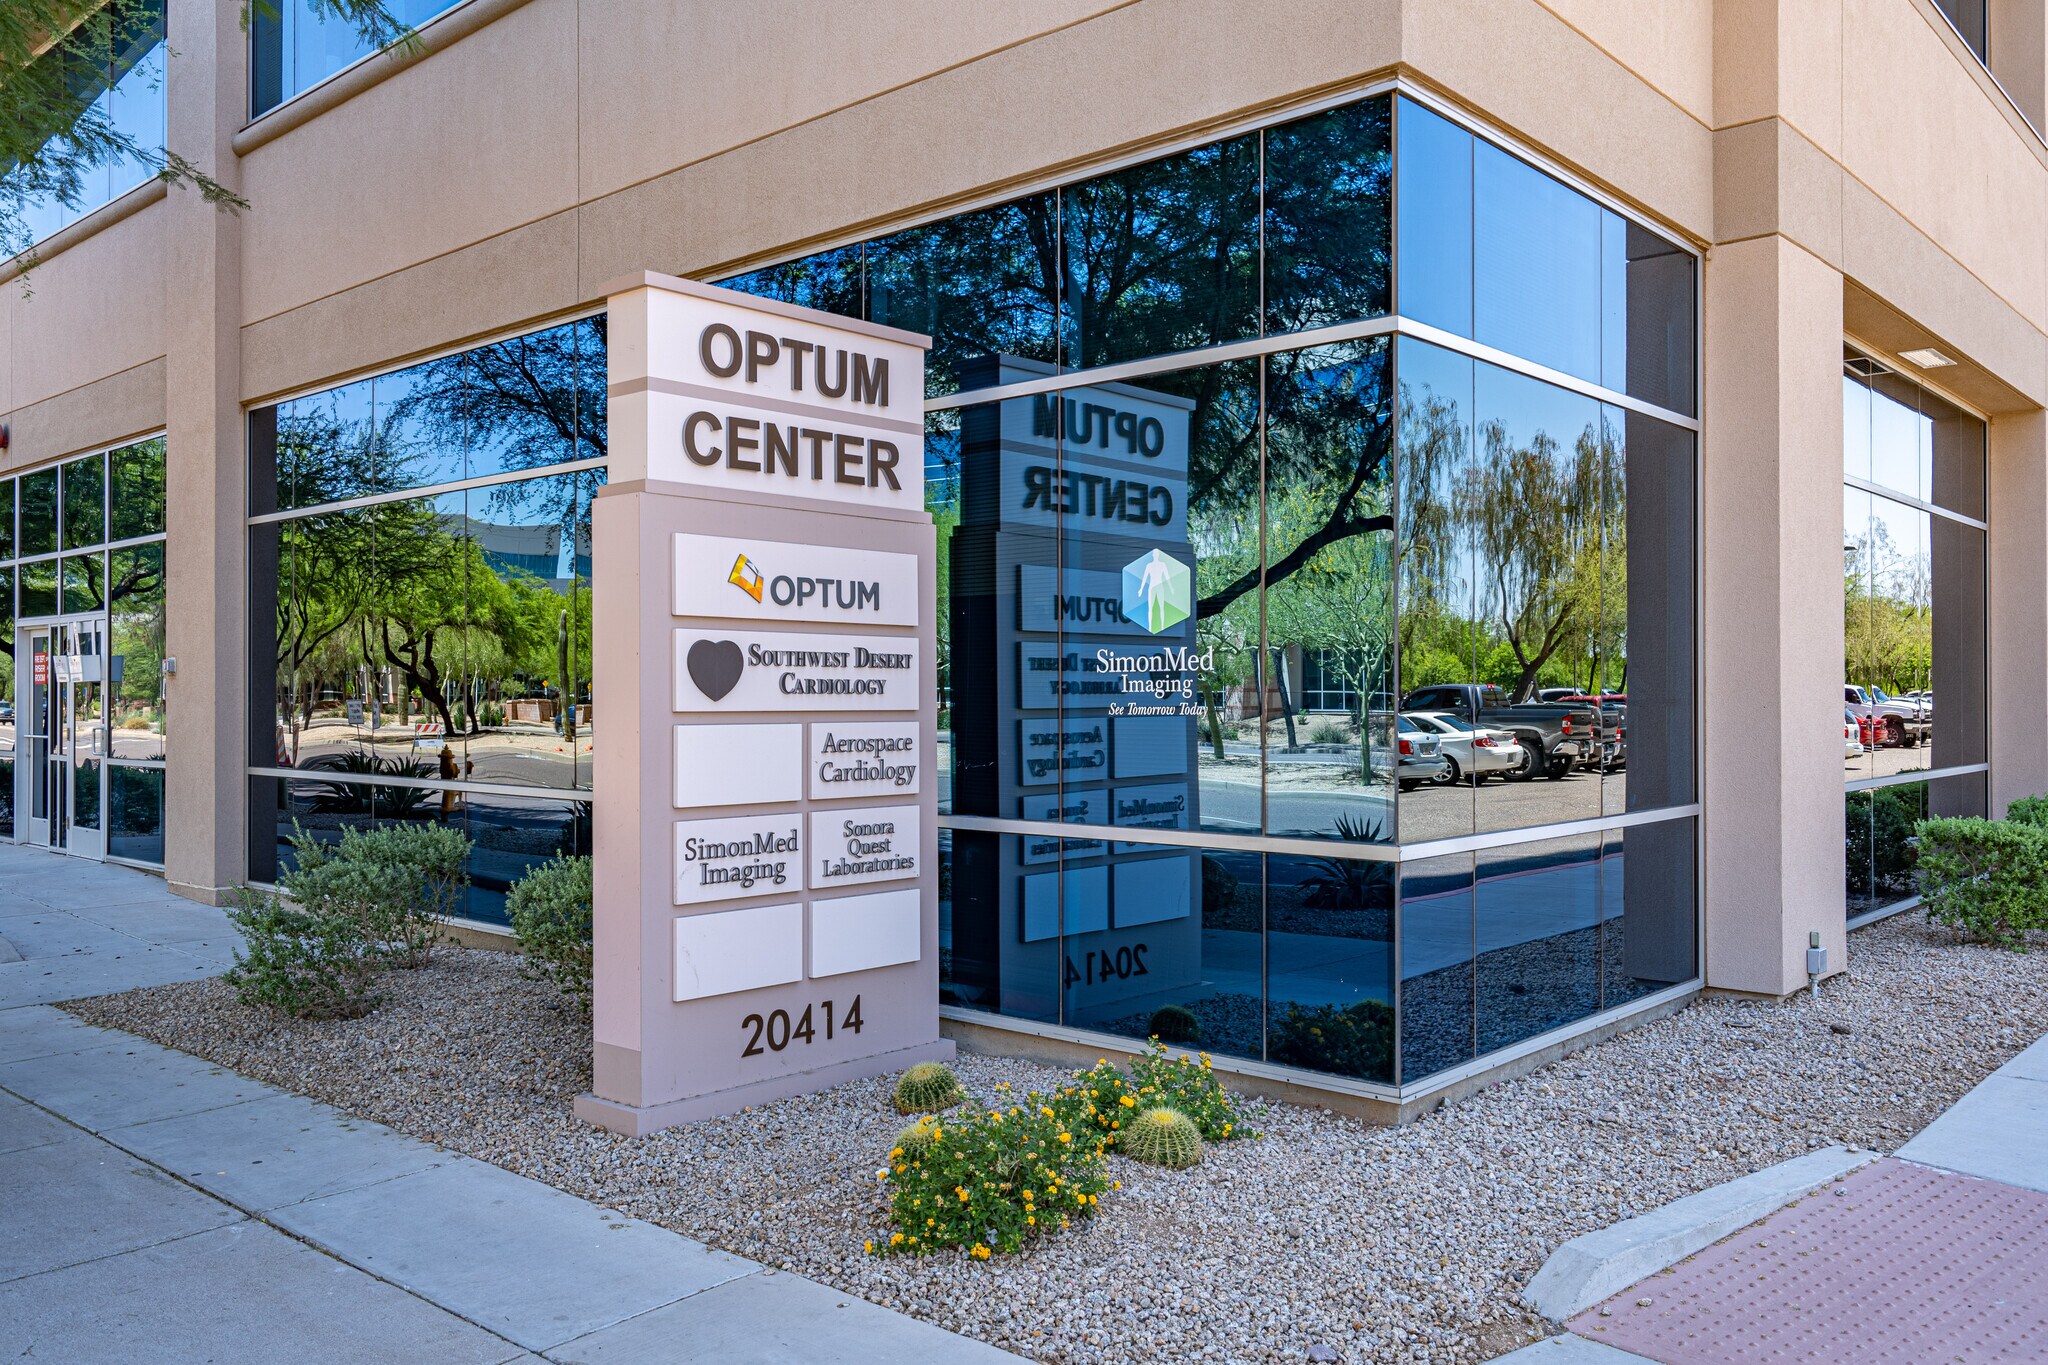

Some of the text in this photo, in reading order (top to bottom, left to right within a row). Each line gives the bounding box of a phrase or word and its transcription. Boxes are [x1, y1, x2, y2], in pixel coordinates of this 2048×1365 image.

[699, 322, 889, 407] OPTUM
[681, 411, 902, 491] CENTER
[770, 575, 880, 611] OPTUM
[1096, 645, 1214, 673] SimonMed
[1121, 674, 1193, 698] Imaging
[1108, 703, 1208, 719] See Tomorrow Today
[821, 732, 913, 758] Aerospace
[819, 759, 917, 786] Cardiology
[843, 820, 895, 838] Sonora
[684, 829, 799, 861] SimonMed
[847, 838, 891, 858] Quest
[700, 858, 787, 888] Imaging
[822, 853, 914, 878] Laboratories
[741, 994, 864, 1058] 20414
